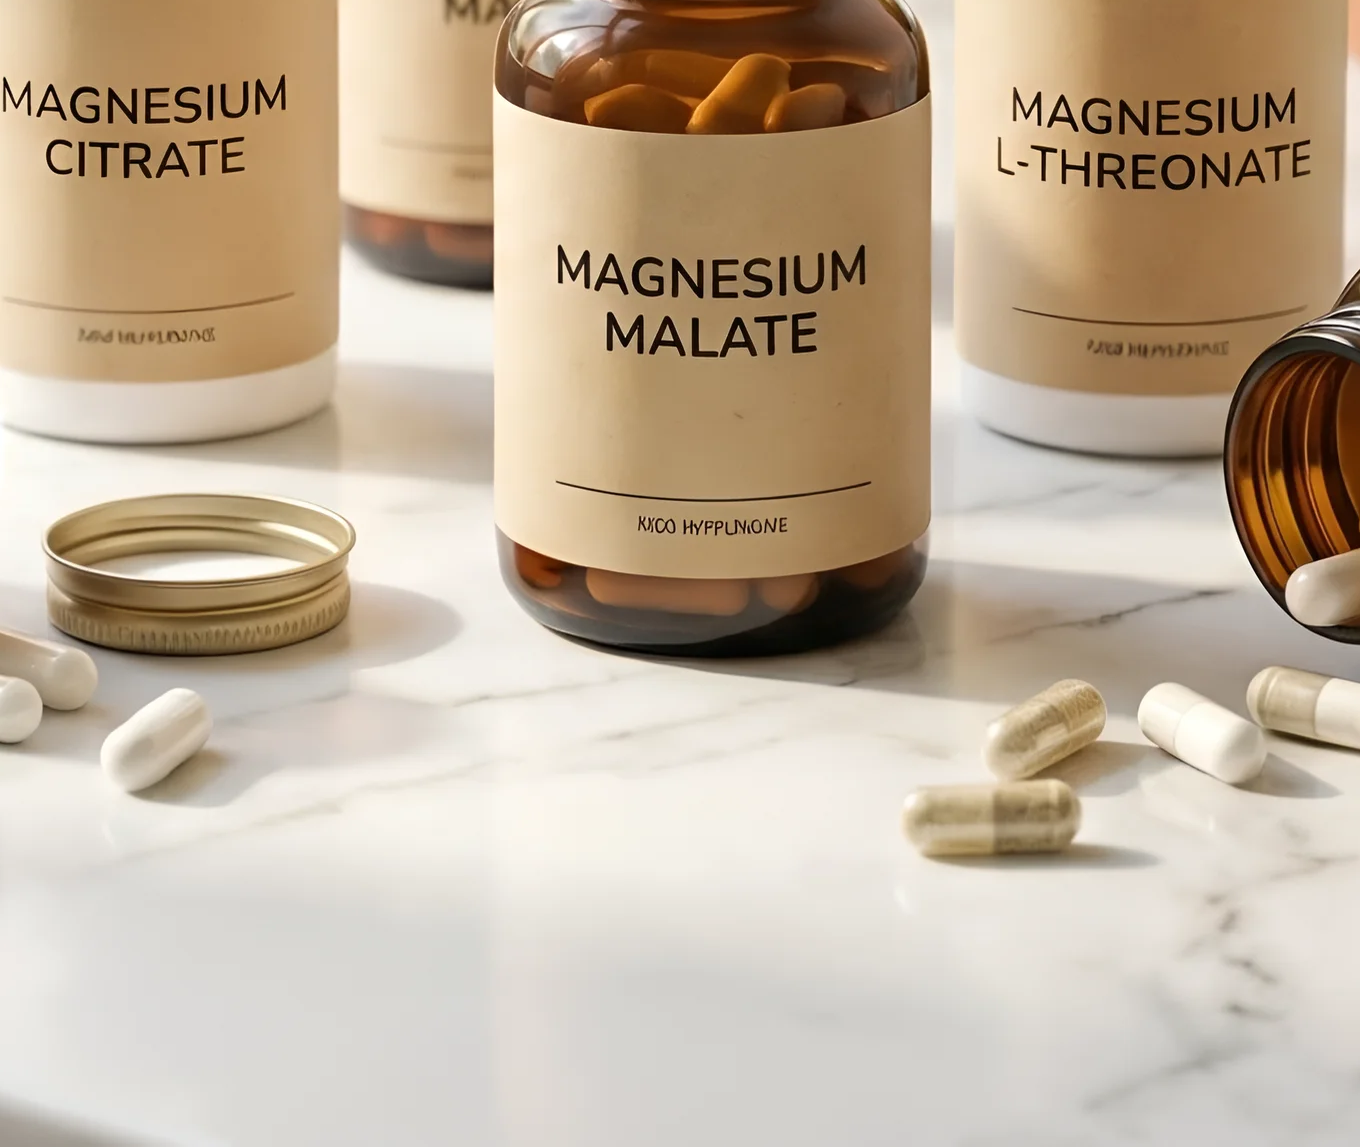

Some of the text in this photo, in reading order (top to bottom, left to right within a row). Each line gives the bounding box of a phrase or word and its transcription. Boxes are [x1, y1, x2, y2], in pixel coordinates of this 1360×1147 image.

[2, 74, 287, 124] MAGNESIUM
[1012, 86, 1296, 136] MAGNESIUM
[45, 136, 246, 179] CITRATE
[997, 136, 1311, 190] L-THREONATE
[556, 244, 867, 299] MAGNESIUM
[605, 311, 818, 358] MALATE
